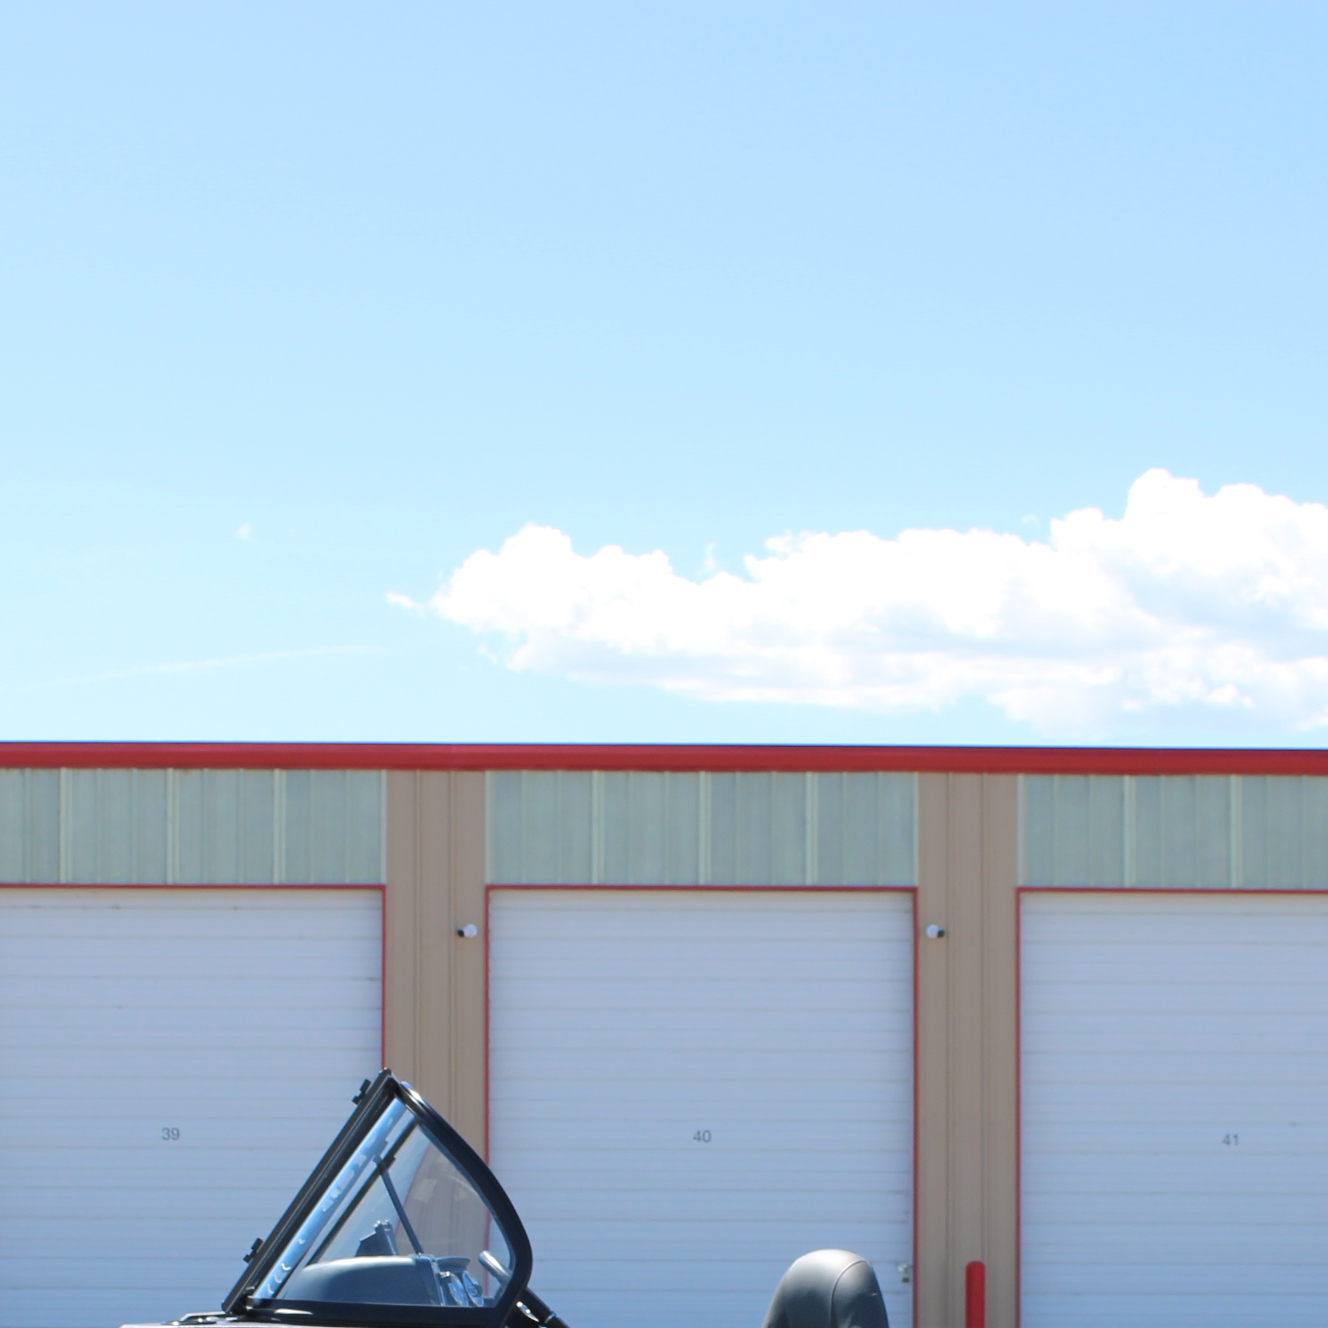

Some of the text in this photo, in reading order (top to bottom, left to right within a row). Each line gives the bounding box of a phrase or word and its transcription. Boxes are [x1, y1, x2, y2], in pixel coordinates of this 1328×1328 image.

[161, 1127, 181, 1141] 39
[693, 1130, 712, 1143] 40
[1222, 1133, 1239, 1146] 41
